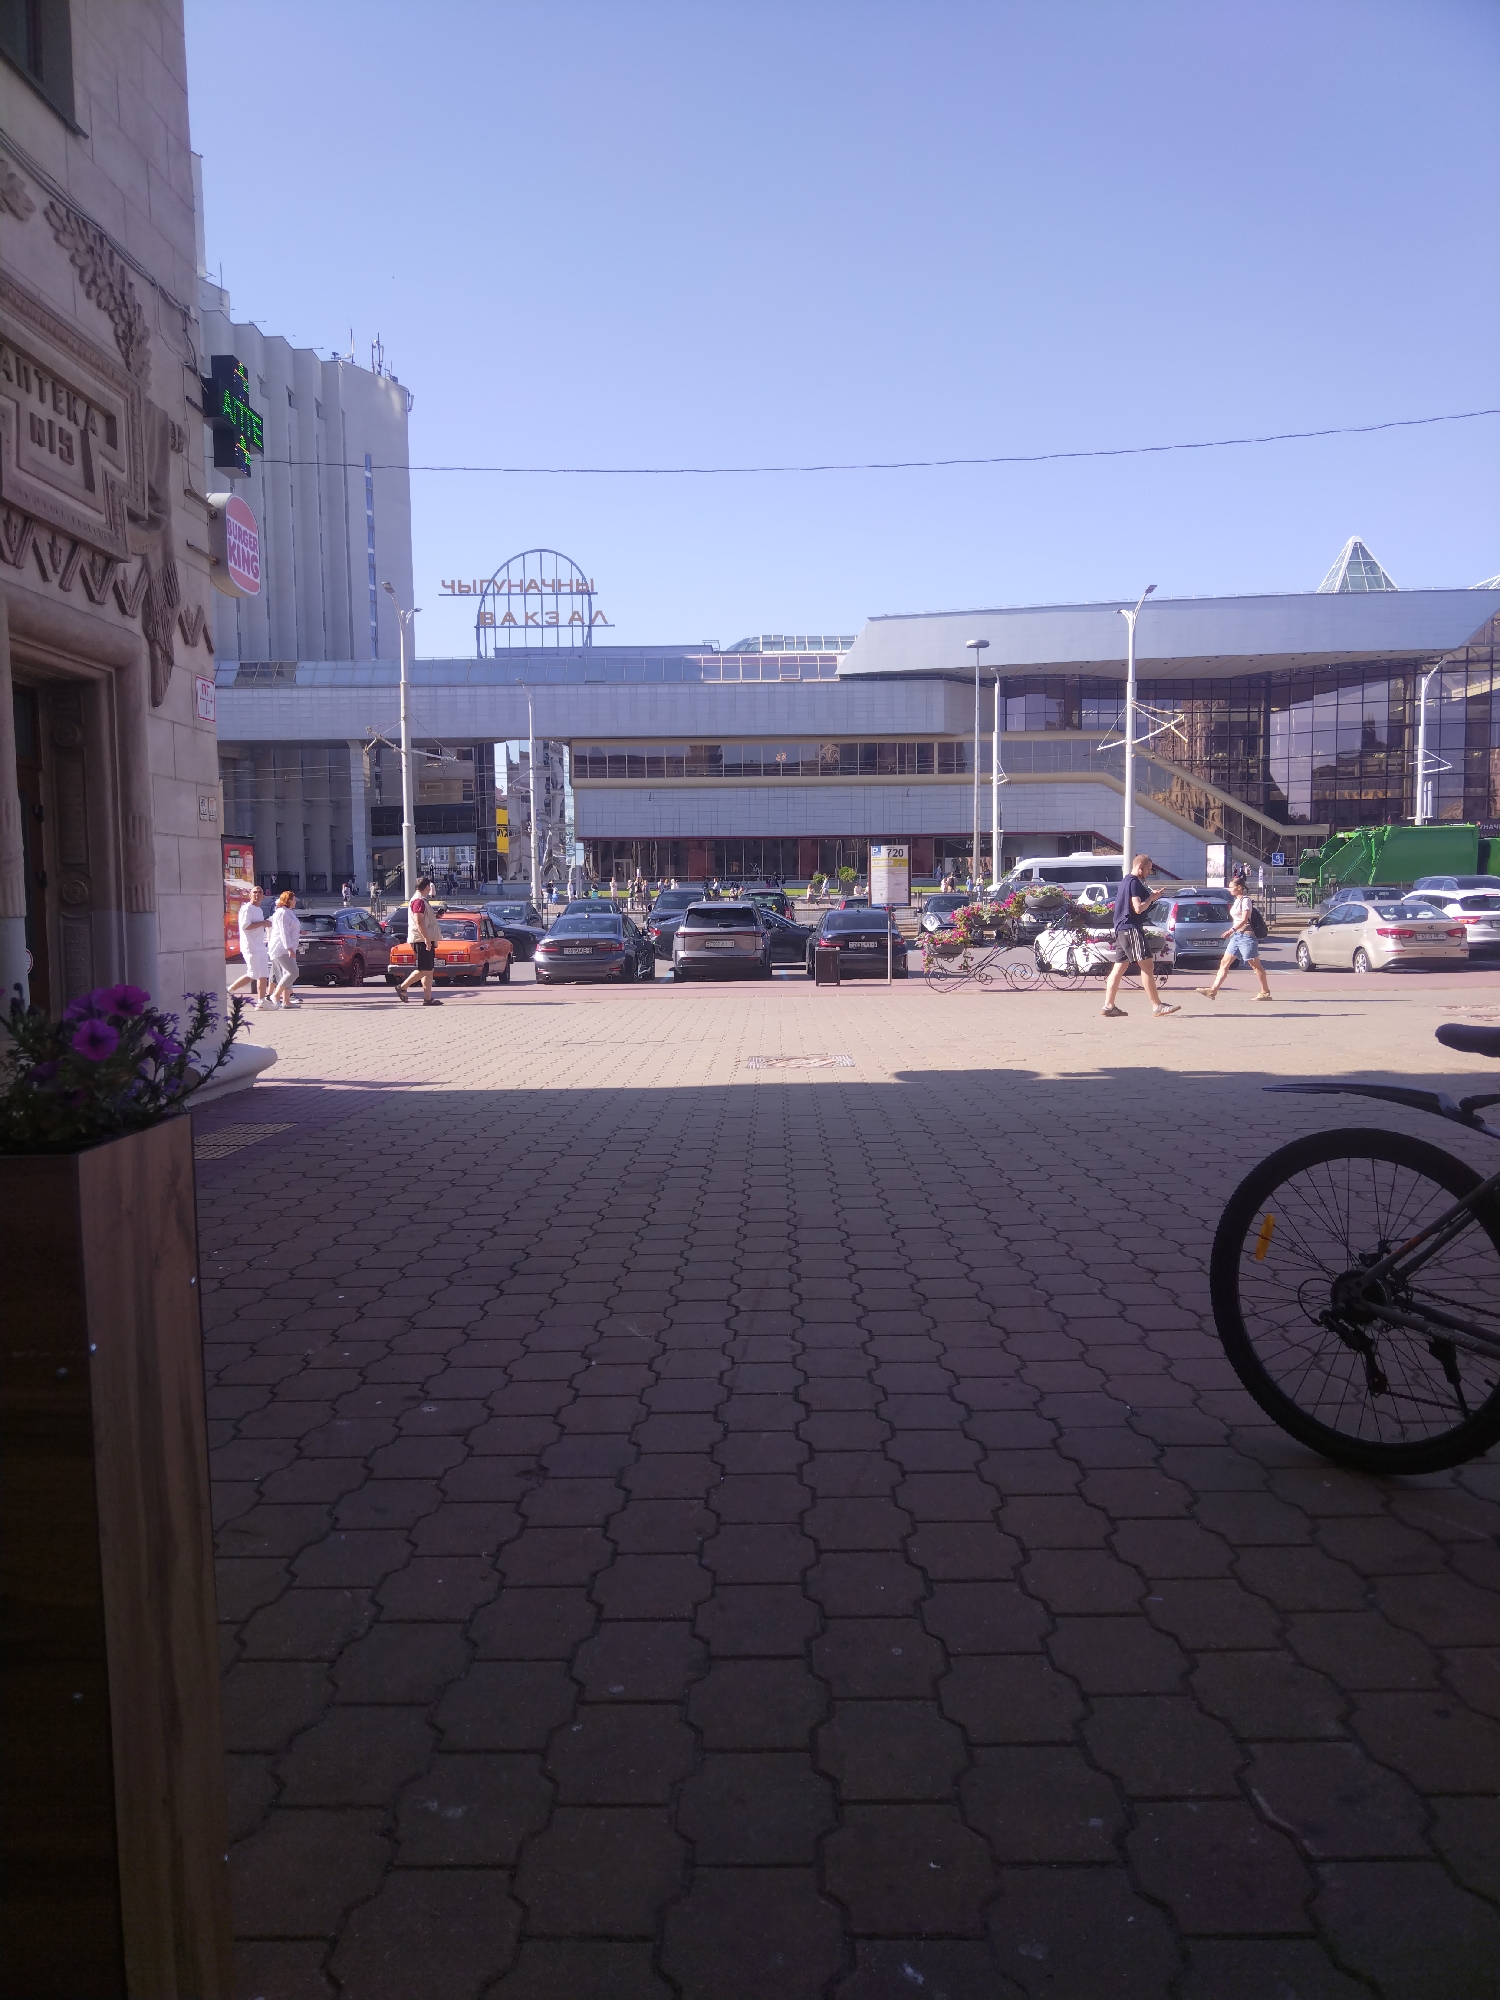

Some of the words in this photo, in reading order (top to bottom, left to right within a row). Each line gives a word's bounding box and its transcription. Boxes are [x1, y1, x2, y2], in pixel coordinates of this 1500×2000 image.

[227, 517, 258, 555] BURGER
[228, 537, 260, 580] KING
[441, 578, 595, 594] ЧЫГУНАЧНЫ
[479, 610, 609, 626] ВАКЗАЛ
[886, 848, 904, 858] 720
